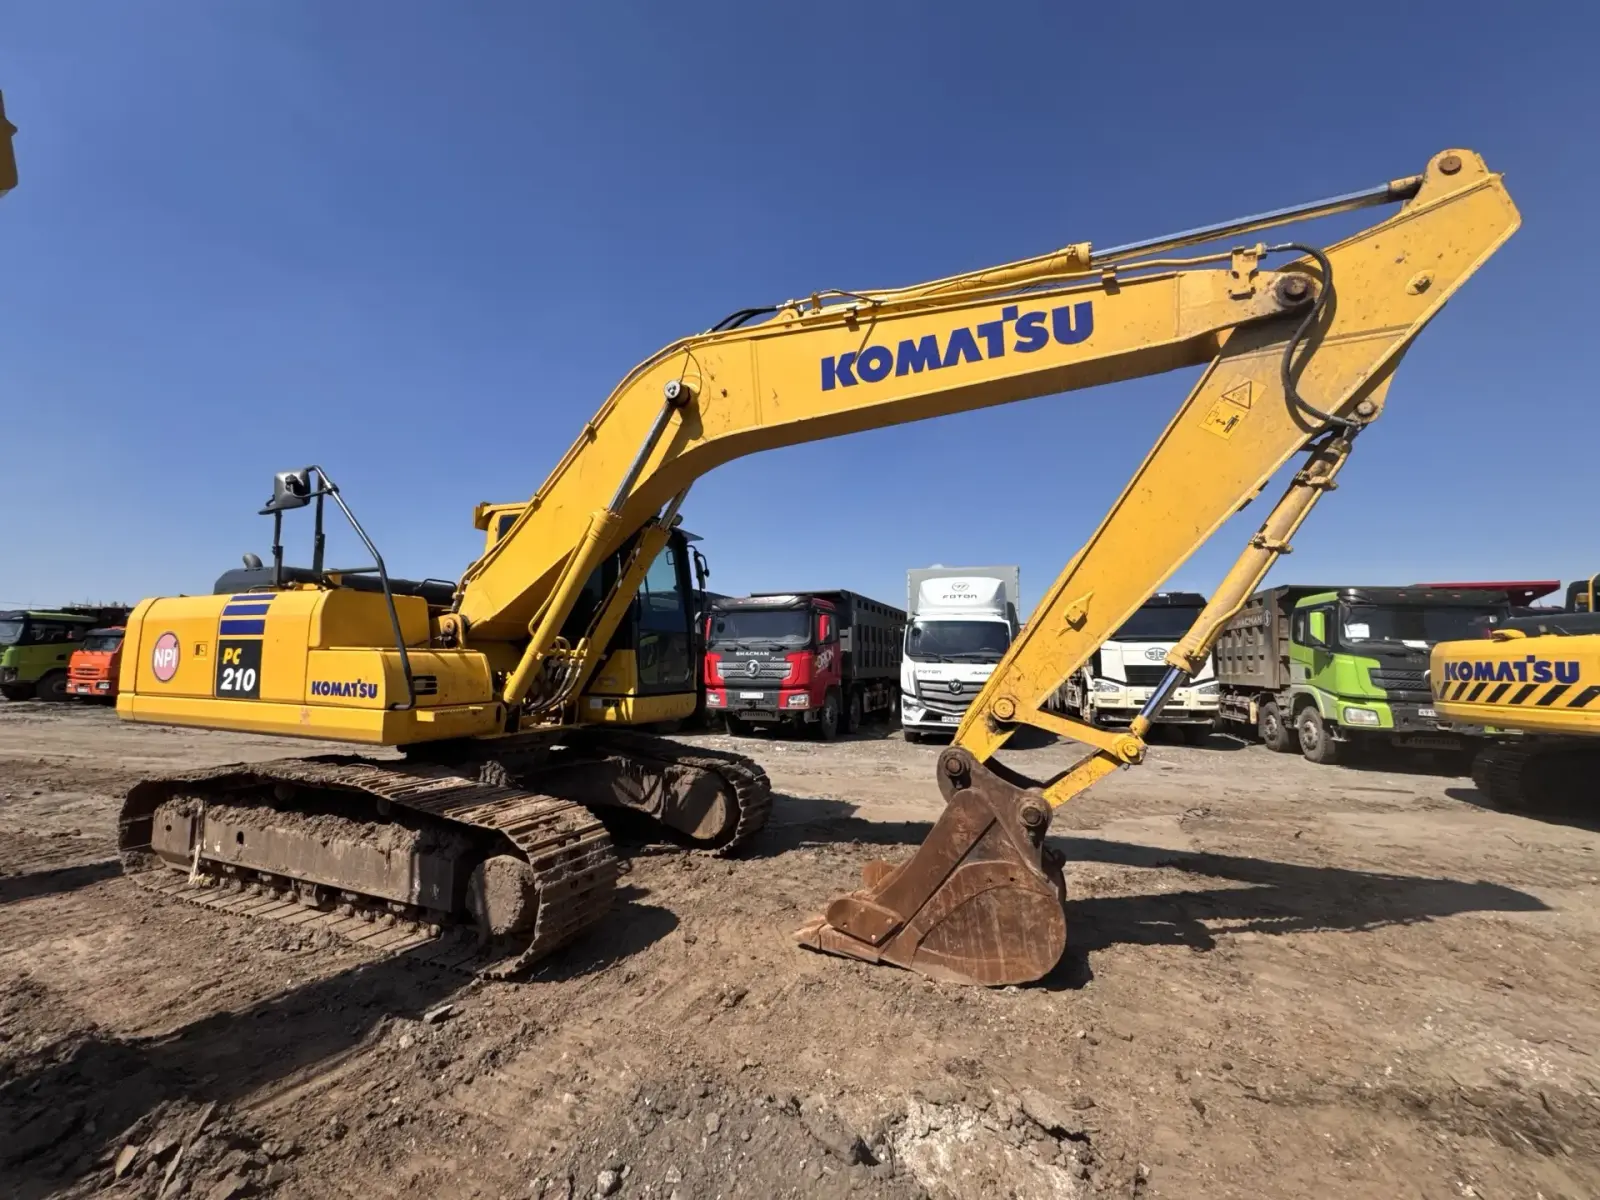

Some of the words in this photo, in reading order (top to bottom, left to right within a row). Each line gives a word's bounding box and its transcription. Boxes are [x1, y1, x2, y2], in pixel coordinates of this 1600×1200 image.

[821, 301, 1093, 391] KOMATSU
[222, 648, 242, 664] PC
[220, 668, 256, 691] 210
[1444, 655, 1580, 683] KOMATSU
[311, 679, 378, 699] KOMATSU
